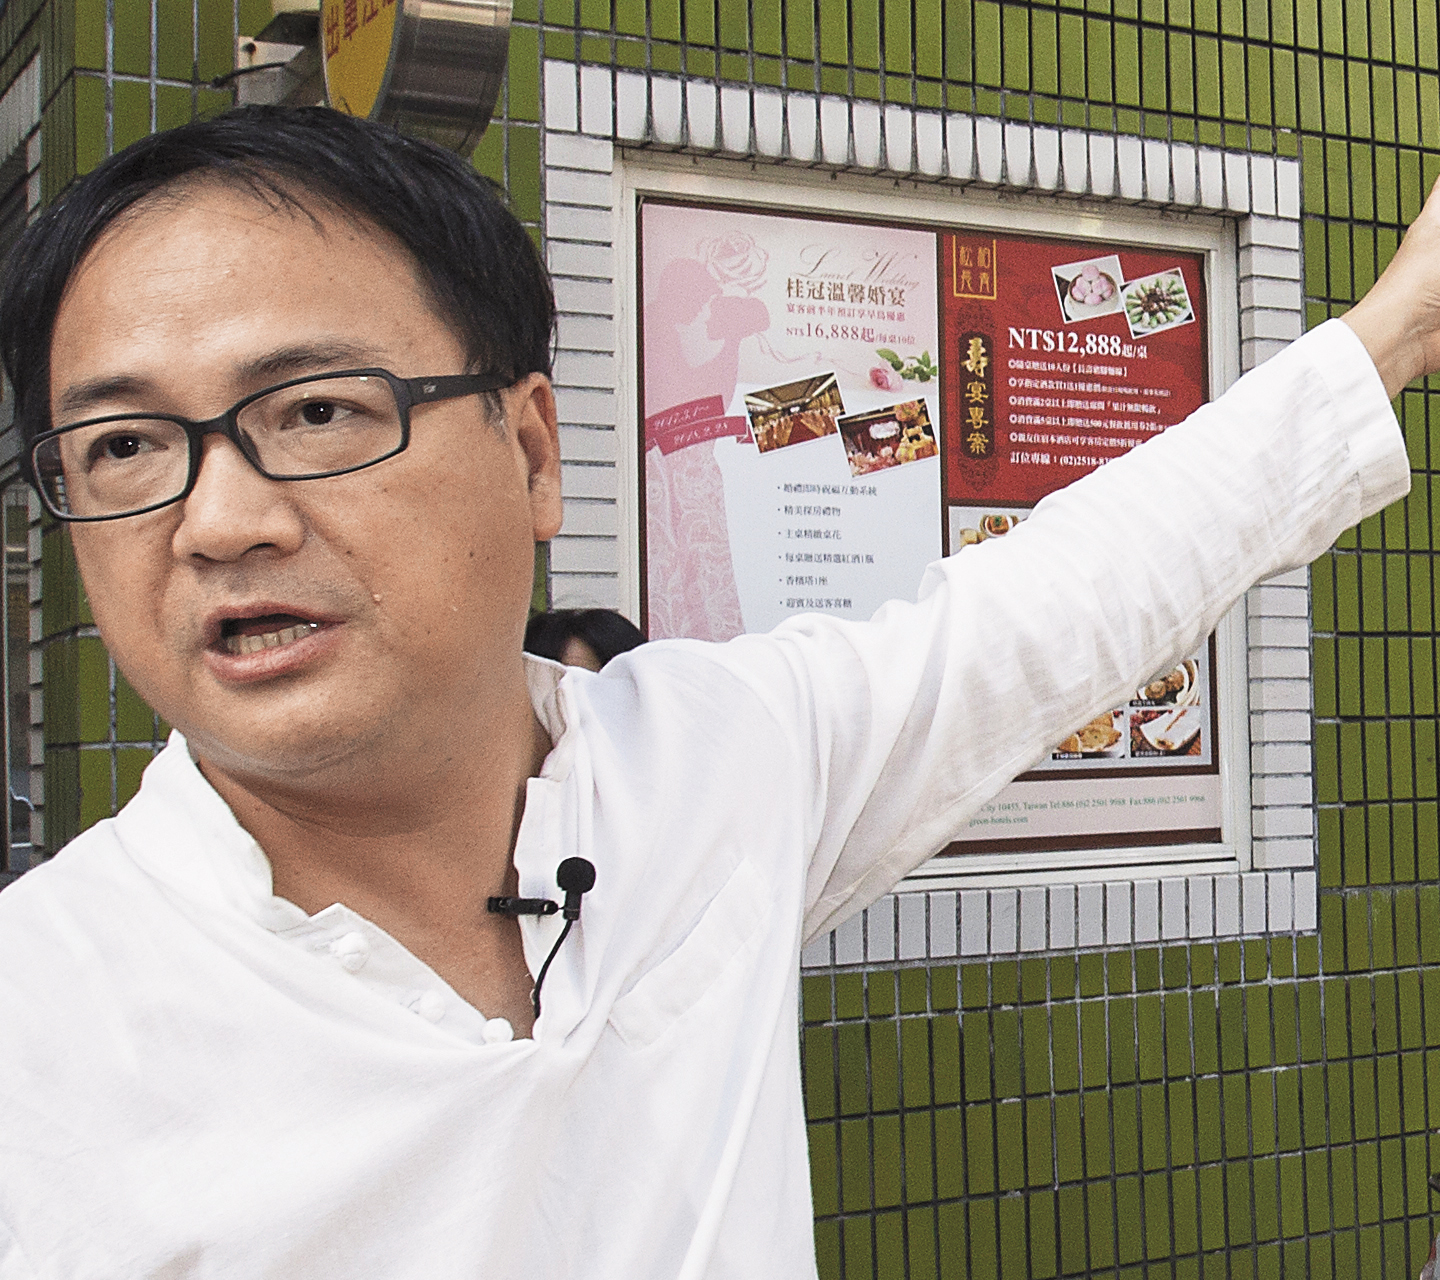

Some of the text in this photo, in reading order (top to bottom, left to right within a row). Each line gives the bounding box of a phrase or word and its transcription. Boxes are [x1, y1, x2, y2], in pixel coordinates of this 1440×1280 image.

[786, 278, 906, 308] 桂冠溫馨婚宴
[968, 815, 1029, 828] green-hotels.com
